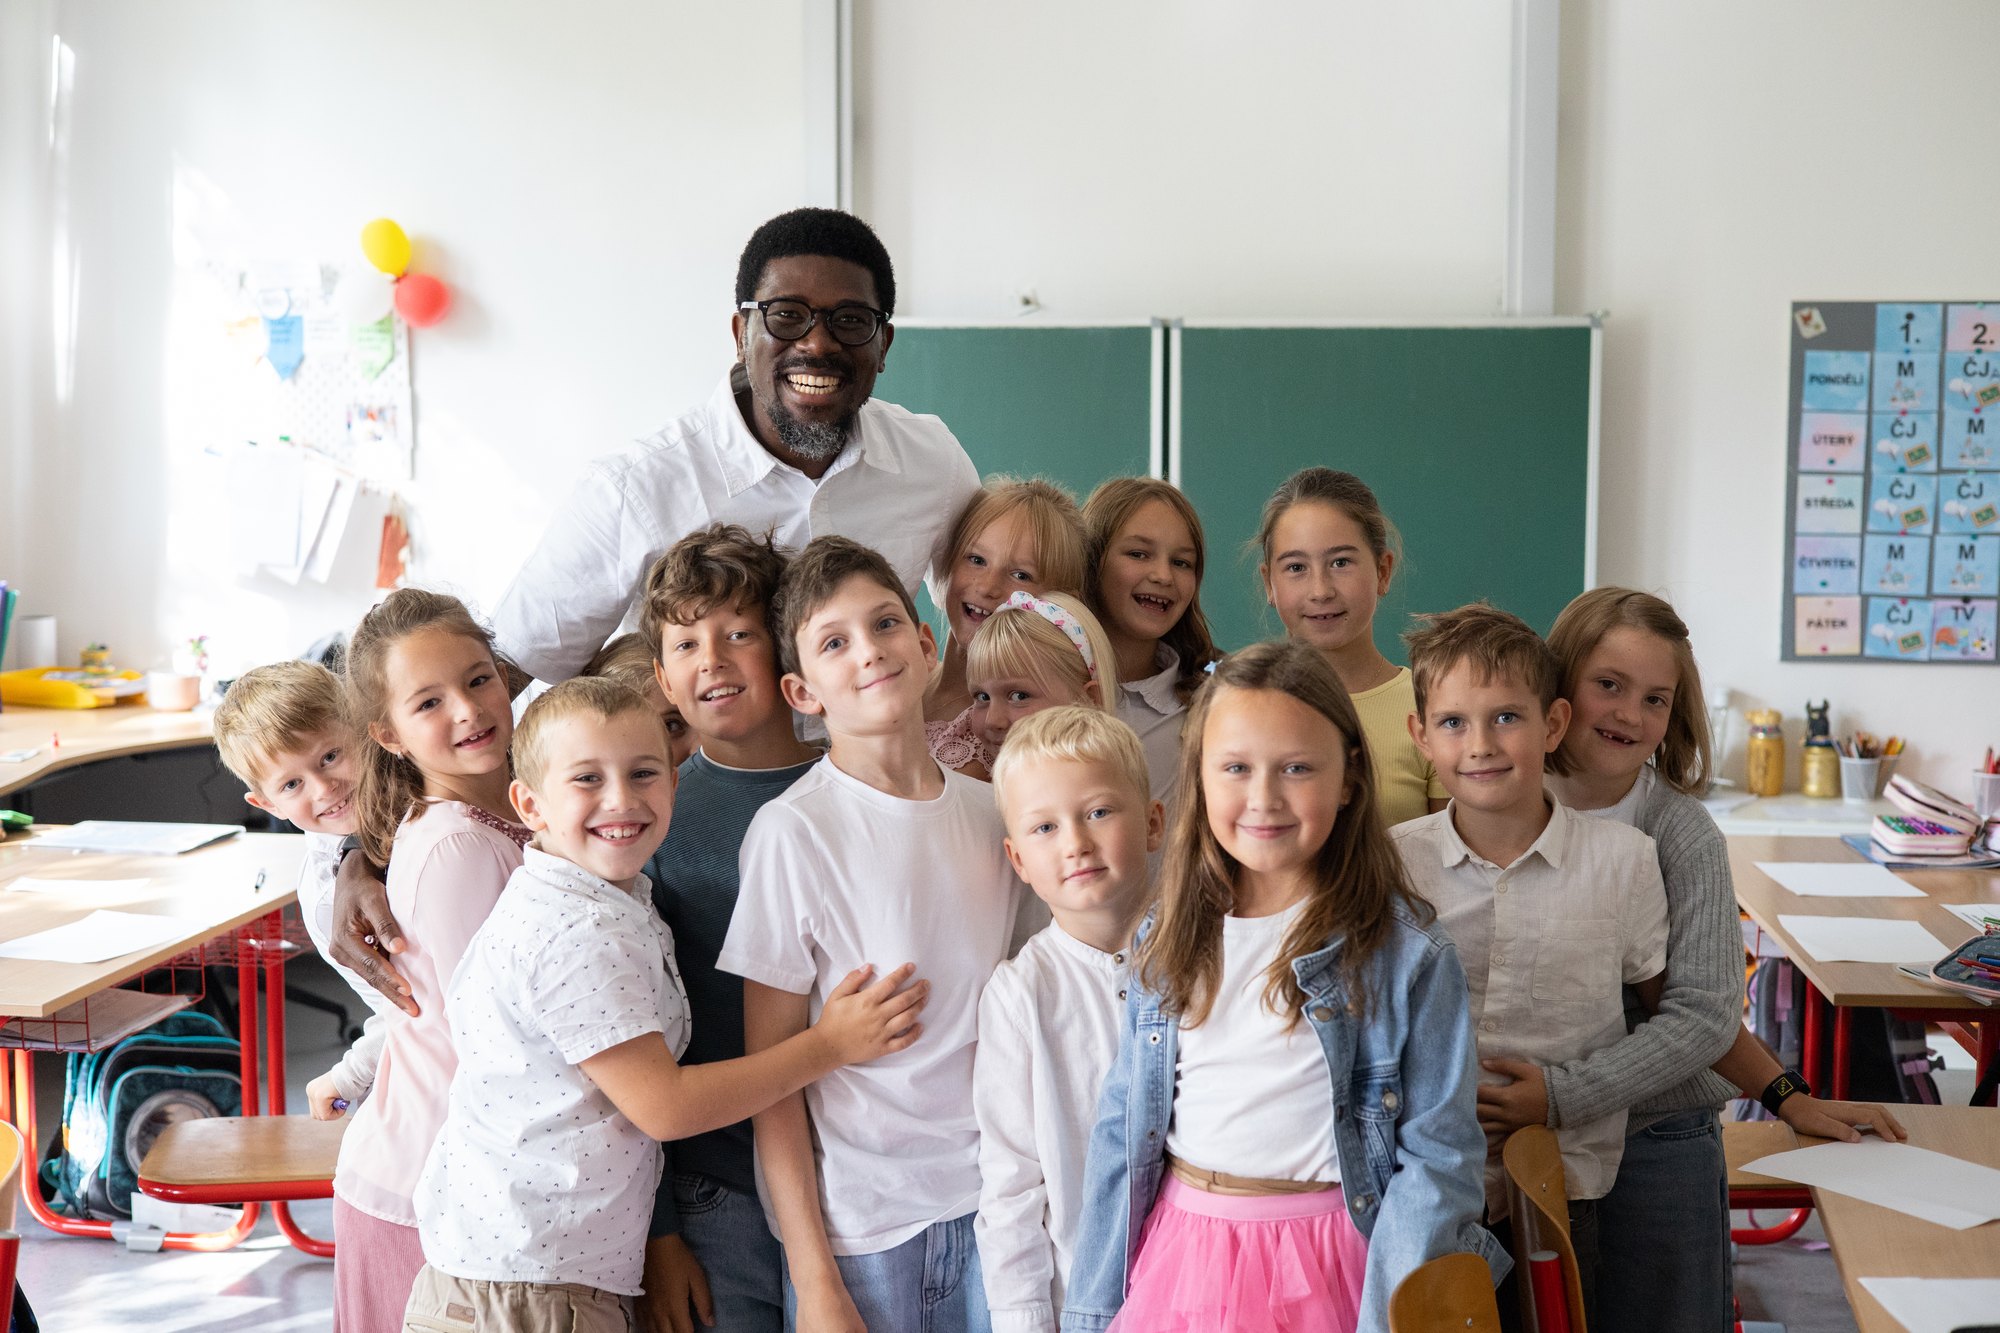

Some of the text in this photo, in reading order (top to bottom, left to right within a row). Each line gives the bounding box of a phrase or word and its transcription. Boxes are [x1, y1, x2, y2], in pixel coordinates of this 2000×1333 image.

[1972, 323, 1995, 345] 2.
[1897, 360, 1914, 377] M
[1963, 356, 1989, 378] ČJ
[1890, 417, 1917, 438] ČJ
[1968, 419, 1985, 434] M
[1889, 479, 1916, 499] ČJ
[1957, 479, 1984, 499] ČJ
[1888, 544, 1904, 560] M
[1959, 544, 1975, 560] M
[1886, 604, 1913, 624] ČJ
[1952, 606, 1976, 621] TV
